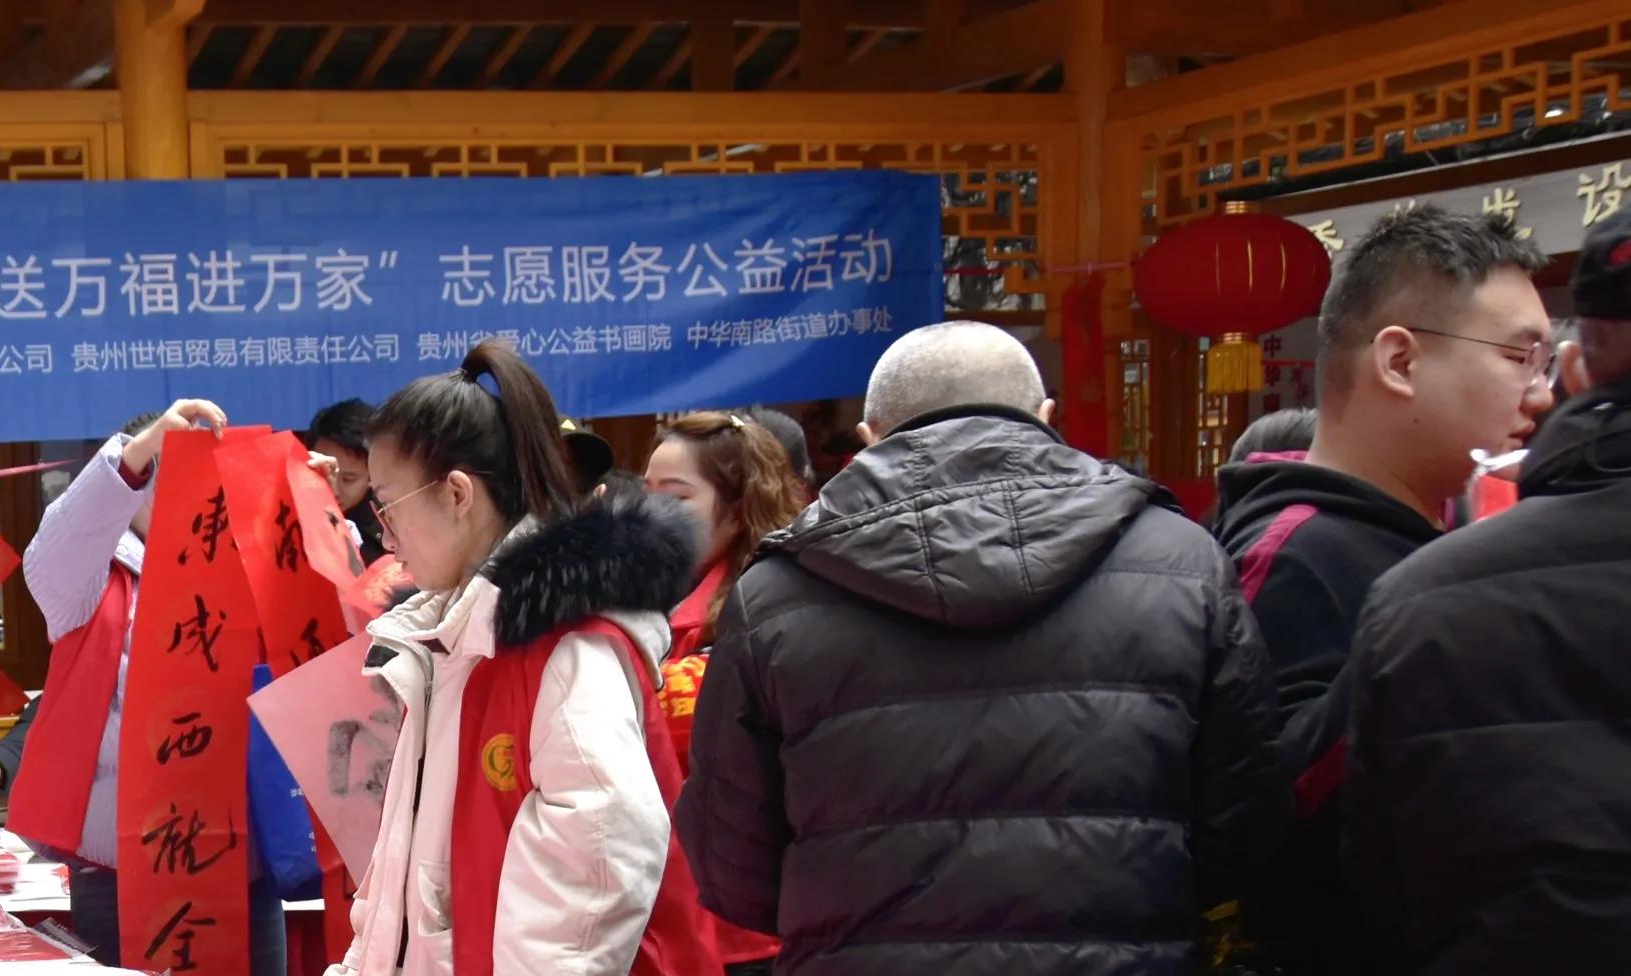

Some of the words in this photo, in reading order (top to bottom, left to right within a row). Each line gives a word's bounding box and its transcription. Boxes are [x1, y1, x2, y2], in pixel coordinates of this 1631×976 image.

[438, 228, 894, 306] 志愿服务公益活动
[71, 332, 399, 373] 贵州世恒贸易有限责任公司
[687, 305, 894, 350] 中华南路街道办事处
